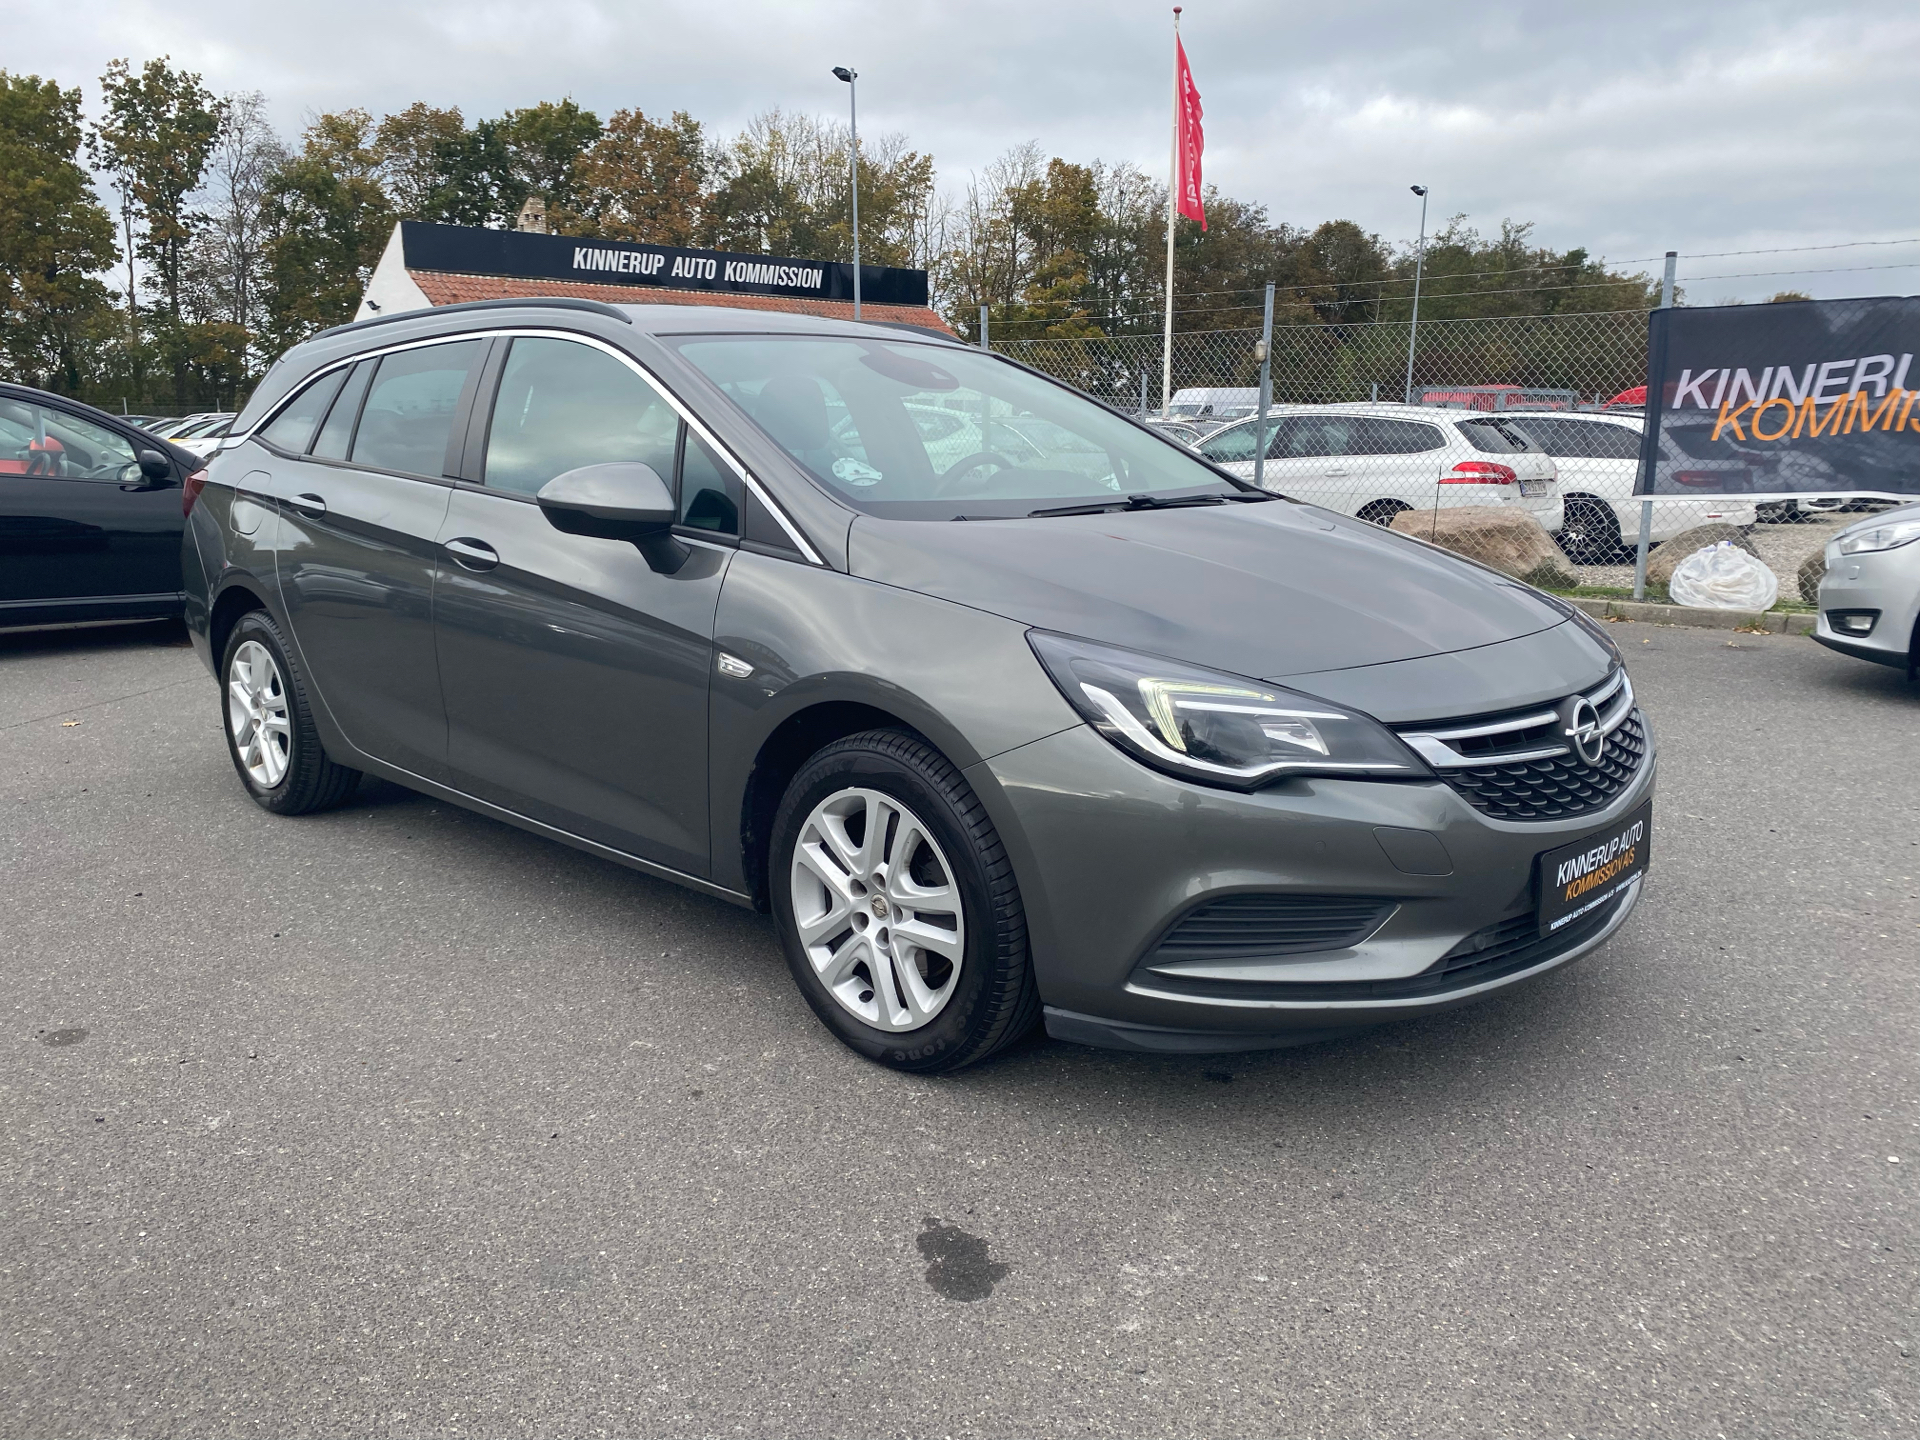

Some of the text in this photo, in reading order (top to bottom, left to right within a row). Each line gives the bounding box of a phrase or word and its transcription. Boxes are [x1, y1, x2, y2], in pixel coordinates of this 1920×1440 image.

[573, 247, 822, 289] KINNERUP AUTO KOMMISSION
[1557, 837, 1619, 887] KINNERUP
[1619, 820, 1644, 854] AUTO
[1565, 859, 1622, 901] KOMMISSION
